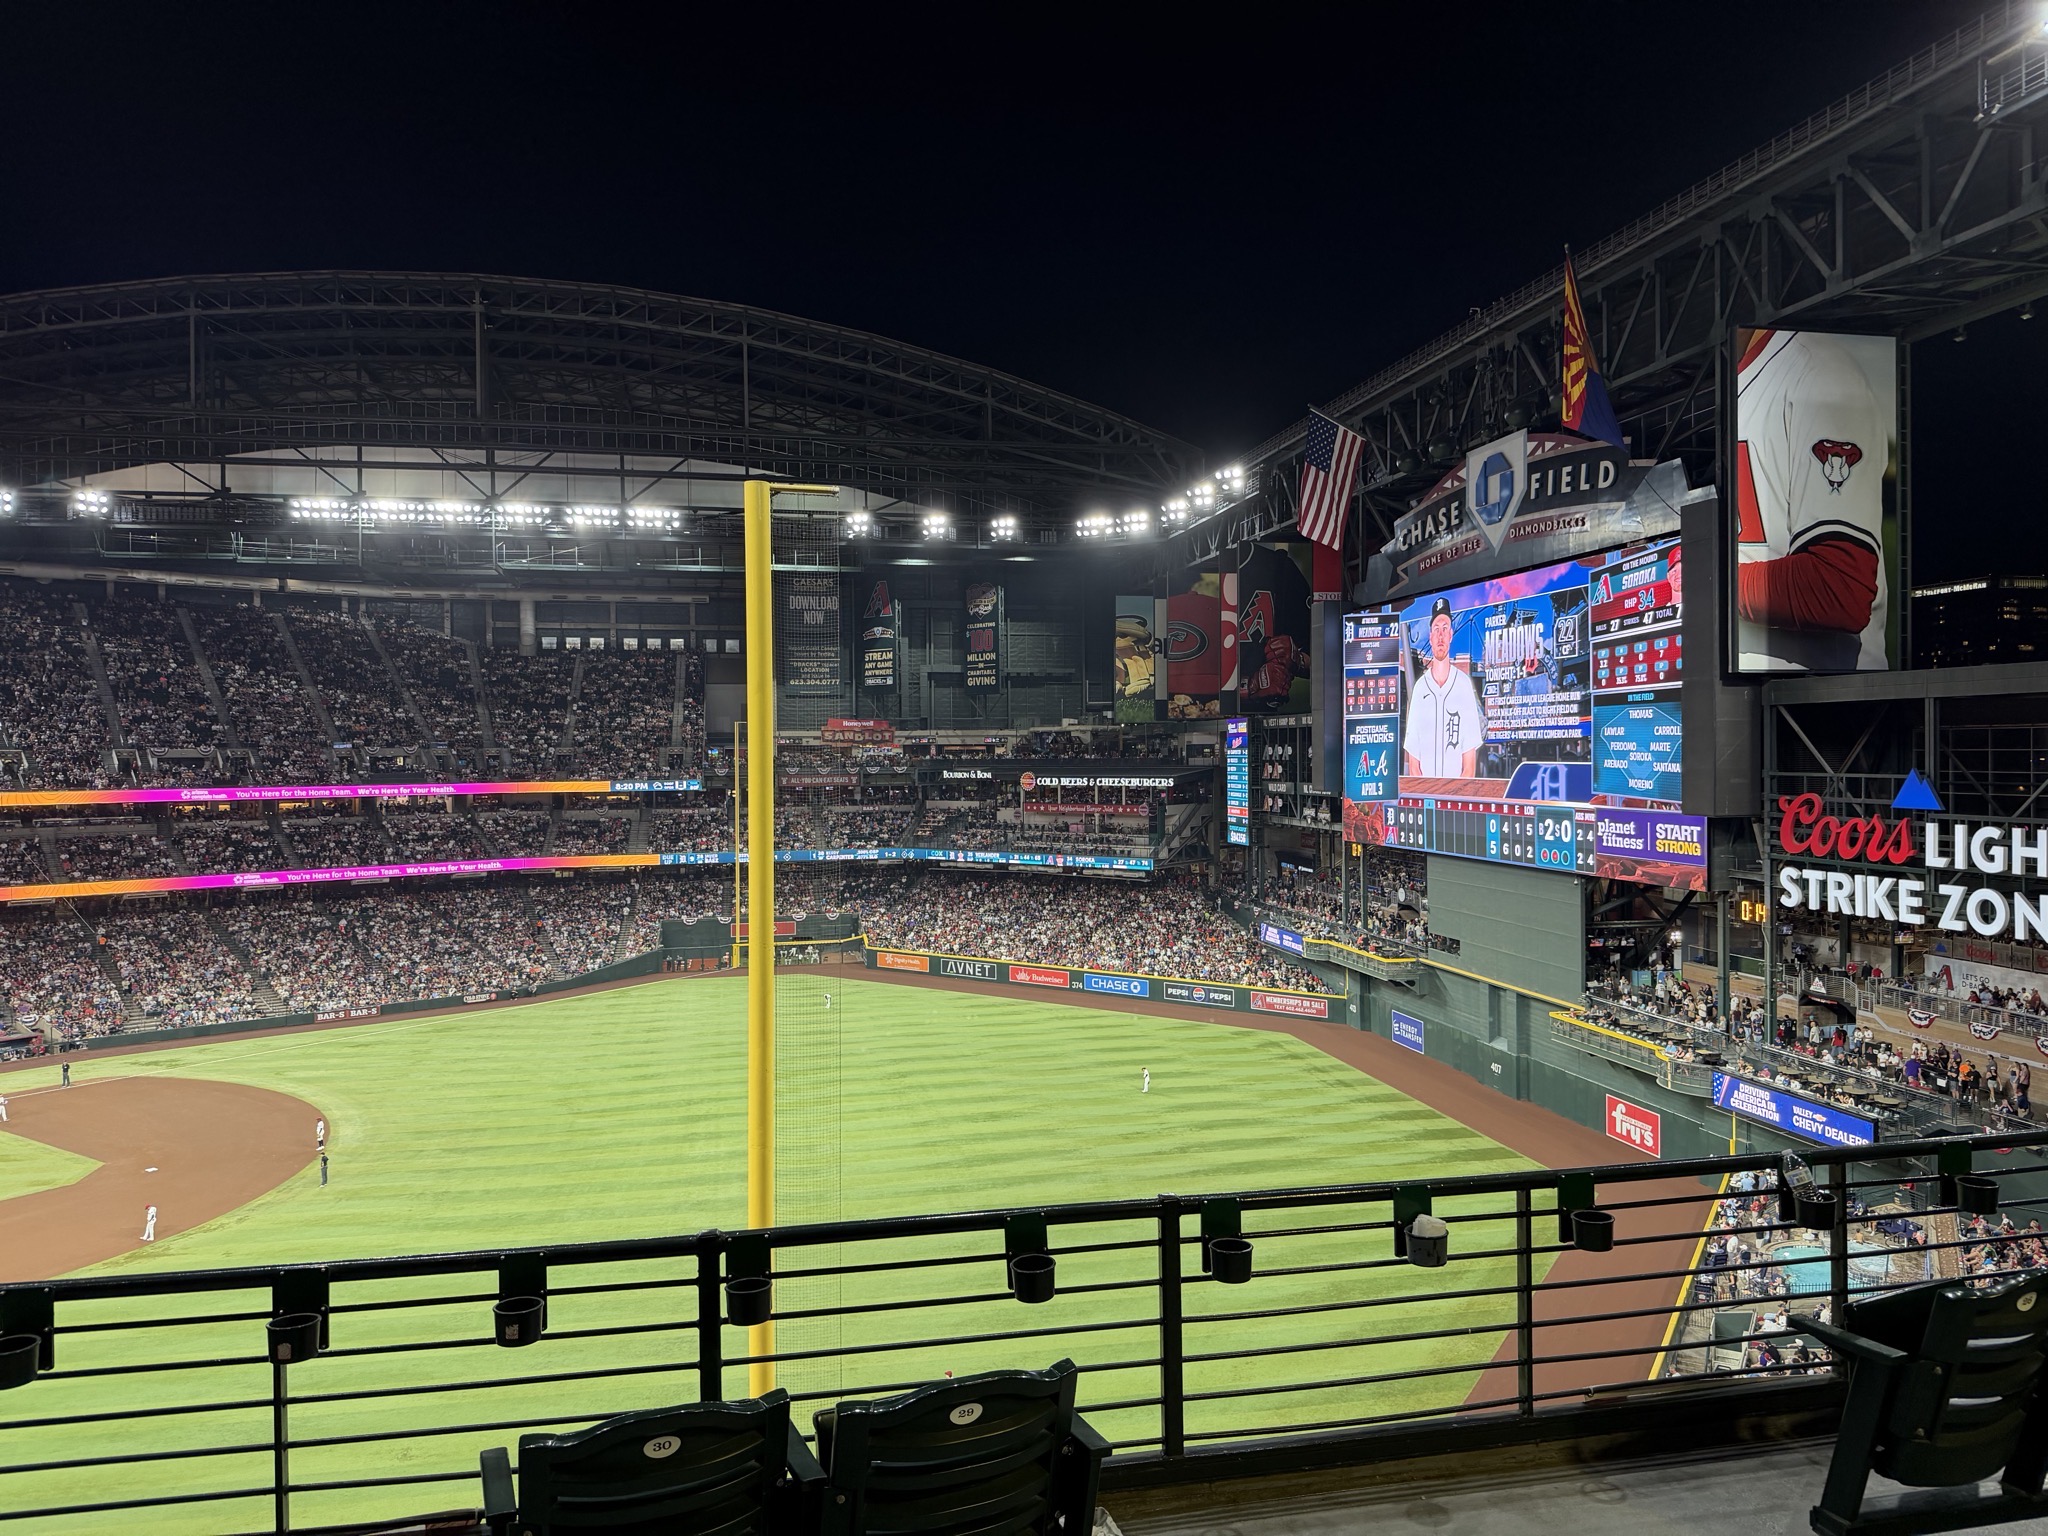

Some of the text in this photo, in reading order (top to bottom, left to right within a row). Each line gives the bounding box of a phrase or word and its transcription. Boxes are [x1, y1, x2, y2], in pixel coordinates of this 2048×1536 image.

[1530, 461, 1615, 500] FIELD
[1400, 501, 1459, 551] CHASE
[1420, 517, 1586, 570] HOME OF THE DIAMONDBACKS
[1630, 554, 1658, 569] THE MOUND
[1622, 567, 1656, 590] SOROKA
[790, 596, 838, 610] DOWNLOAD
[1624, 588, 1656, 610] RHP 34
[804, 611, 824, 624] NOW
[1485, 614, 1506, 628] PARKER
[1610, 608, 1673, 631] 27 47 TOTAL
[1359, 623, 1398, 637] MEADOWS 22
[1558, 619, 1574, 642] 22
[1484, 623, 1544, 666] MEADOWS
[865, 652, 893, 661] STREAM
[967, 653, 996, 662] MILLION
[1485, 666, 1516, 681] TONIGHT:
[967, 676, 996, 686] GIVING
[1538, 693, 1556, 702] LEAGUE
[1556, 692, 1569, 701] HOME
[1557, 704, 1570, 713] FIELD
[1629, 709, 1653, 718] THOMAS
[1528, 717, 1580, 726] ASTROS THAT SECURED
[822, 731, 893, 740] SANDLOT
[1356, 725, 1388, 734] POSTGAME
[1518, 729, 1582, 739] VICTORY COMERICA PARK
[1604, 726, 1682, 735] LAWLAR CARROLL
[1350, 733, 1394, 744] FIREWORKS
[1610, 742, 1671, 752] PERDOMO MARTE
[1630, 752, 1652, 761] SOROKA
[1604, 760, 1681, 772] ARENADO SANTANA
[615, 782, 634, 790] 8:20
[1096, 778, 1174, 787] CHEESEBURGERS
[1268, 784, 1286, 792] WILD CARD
[1629, 779, 1653, 789] MORENO
[1362, 783, 1377, 796] APRIL
[1087, 805, 1101, 813] Burger
[1524, 806, 1535, 815] LOB
[1490, 819, 1572, 842] 0 4 5 2 0
[1597, 819, 1636, 836] planet
[1656, 823, 1701, 842] START
[1576, 829, 1594, 841] 2 4
[1778, 793, 2048, 878] Coors LIGH
[1602, 833, 1644, 850] fitness
[1490, 841, 1584, 864] 5 6 0 2 2
[1656, 840, 1701, 856] STRONG
[1742, 901, 1766, 922] 0:14
[1780, 866, 2048, 946] STRIKE ZON
[947, 961, 990, 976] AVNET
[1032, 974, 1064, 984] Budweiser
[1963, 973, 1977, 981] LET'S
[1072, 981, 1082, 989] 374
[1092, 978, 1129, 991] CHASE
[1168, 988, 1188, 997] PEPSI
[1210, 993, 1231, 1001] PEPSI
[1266, 996, 1302, 1007] MEMBERSHIPS
[317, 1008, 377, 1020] BAR-S BAR-S
[1400, 1022, 1418, 1034] ENERGY
[1400, 1029, 1422, 1044] TRANSFER
[1490, 1062, 1502, 1074] 407
[1739, 1083, 1770, 1100] DRIVING
[1733, 1090, 1776, 1111] AMERICA IN
[1730, 1098, 1779, 1122] CELEBRATION
[1792, 1106, 1813, 1119] VALLEY
[1611, 1103, 1654, 1147] fry's
[1792, 1116, 1869, 1145] CHEVY DEALERS
[958, 1408, 974, 1418] 29
[653, 1441, 671, 1452] 30
